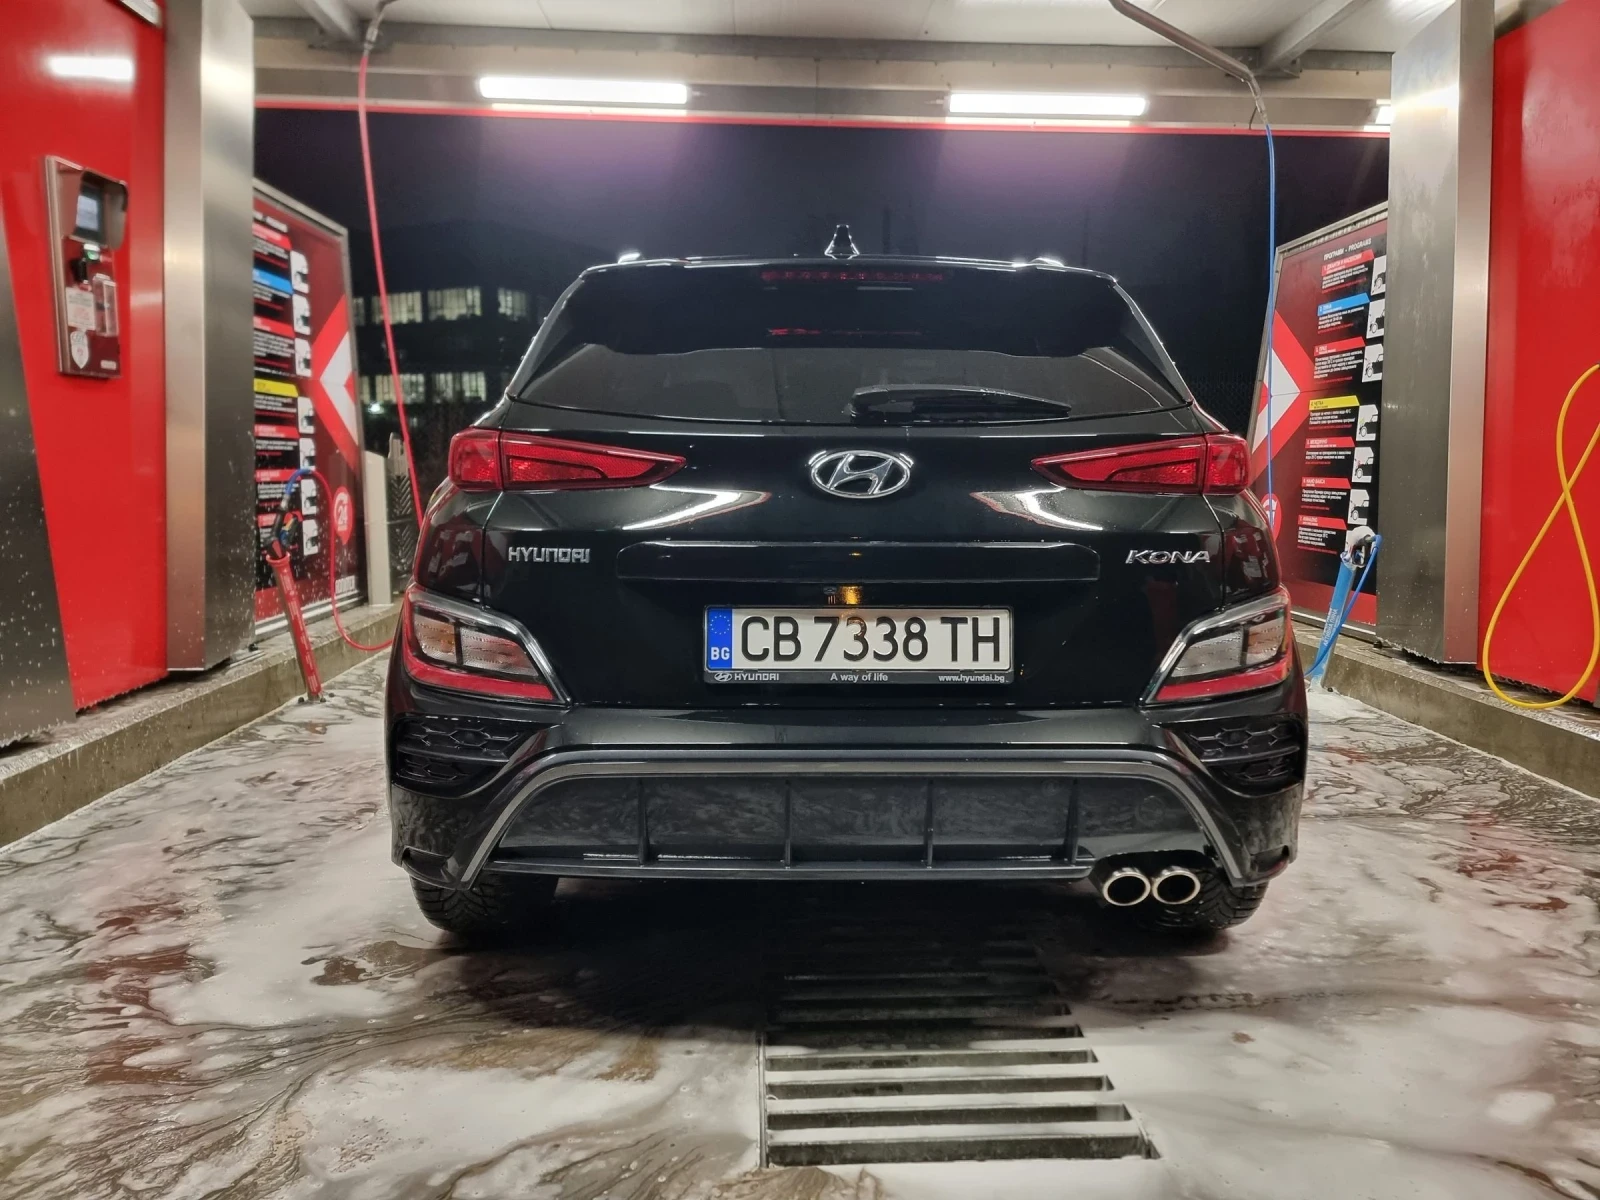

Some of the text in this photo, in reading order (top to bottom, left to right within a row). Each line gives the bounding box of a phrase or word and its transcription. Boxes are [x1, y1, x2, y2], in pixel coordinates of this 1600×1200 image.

[1348, 237, 1372, 252] PROGRAMS
[508, 546, 591, 563] HYUNDAI
[1125, 549, 1211, 564] KONA
[741, 616, 1000, 662] CB 7338 TH
[710, 647, 730, 660] BG
[734, 673, 780, 681] HYUNDAI
[830, 673, 889, 683] A way of life
[938, 673, 1005, 683] www.hyundai.bg
